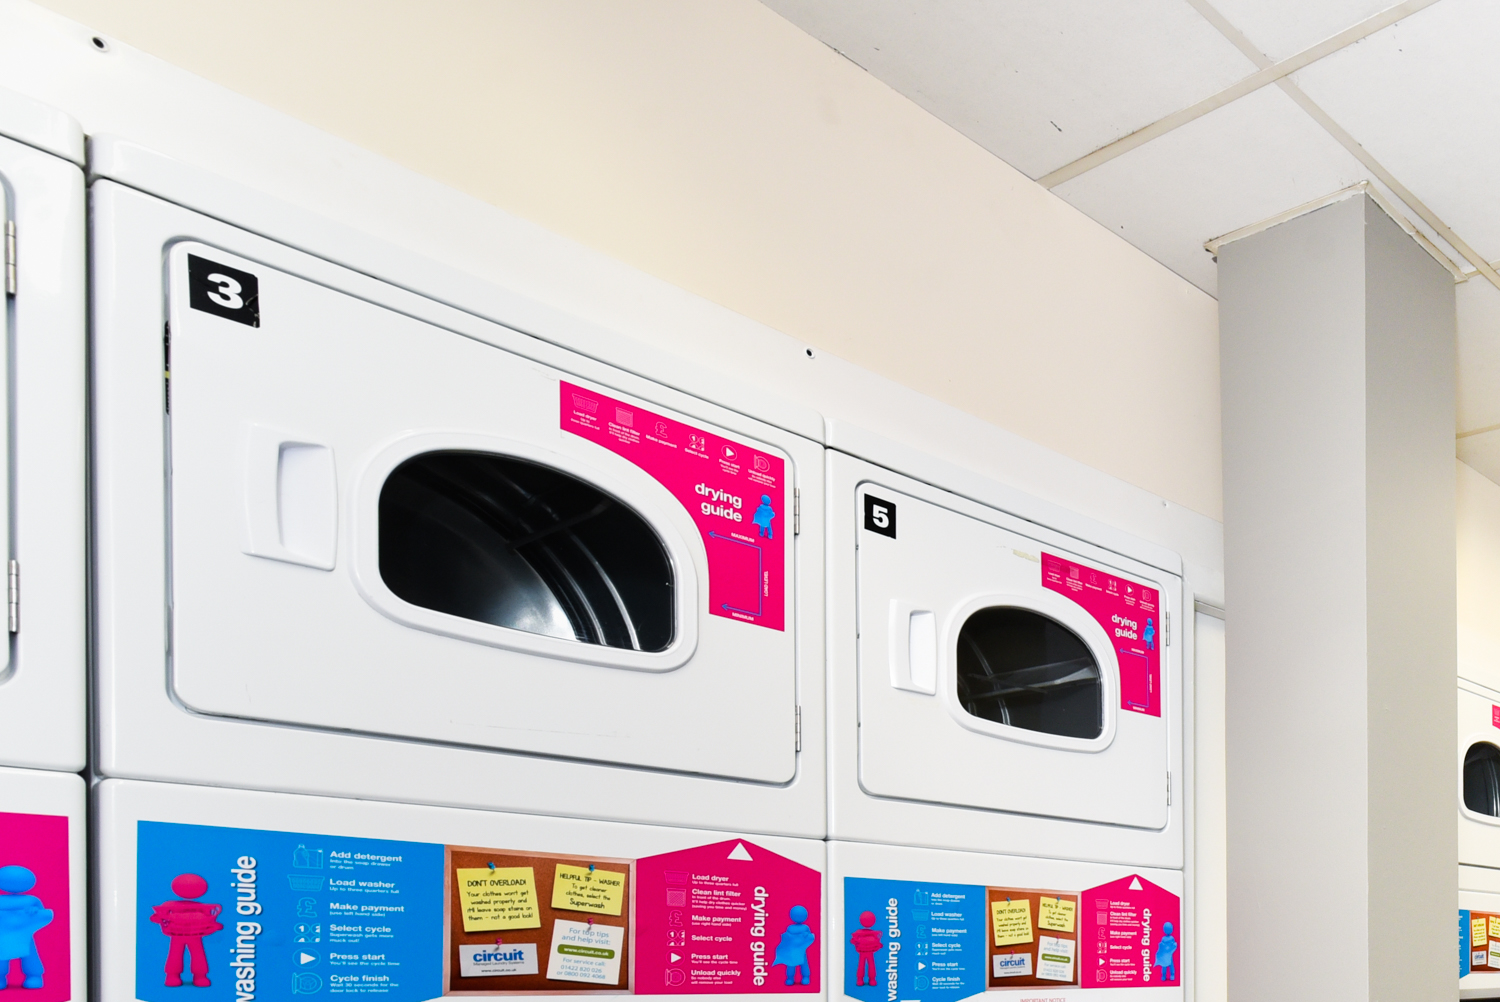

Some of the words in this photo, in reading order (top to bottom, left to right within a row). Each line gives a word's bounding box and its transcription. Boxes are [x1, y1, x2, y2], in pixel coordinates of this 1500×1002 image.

[207, 273, 244, 310] 3
[695, 483, 742, 509] drying
[701, 502, 742, 522] guide
[872, 505, 889, 528] 5
[1112, 614, 1137, 630] drying
[1115, 628, 1137, 640] guide
[330, 851, 350, 860] Add
[353, 852, 403, 864] detergent
[230, 855, 262, 916] guide
[330, 878, 356, 887] Load
[359, 880, 395, 889] washer
[467, 879, 488, 887] DON'T
[711, 875, 729, 883] dryer
[330, 903, 356, 911] Make
[358, 904, 405, 914] payment
[570, 898, 605, 909] Superwash
[750, 886, 769, 937] drying
[886, 898, 901, 938] guide
[712, 916, 742, 924] payment
[330, 924, 361, 932] Select
[364, 925, 391, 934] cycle
[1141, 908, 1152, 946] drying
[578, 936, 593, 944] help
[597, 931, 609, 939] tips
[473, 949, 524, 963] circuit
[1000, 958, 1025, 967] circuit
[750, 941, 769, 987] guide
[1141, 948, 1152, 982] guide
[330, 975, 359, 983] Cycle
[362, 974, 390, 982] finish
[886, 942, 901, 1002] washing
